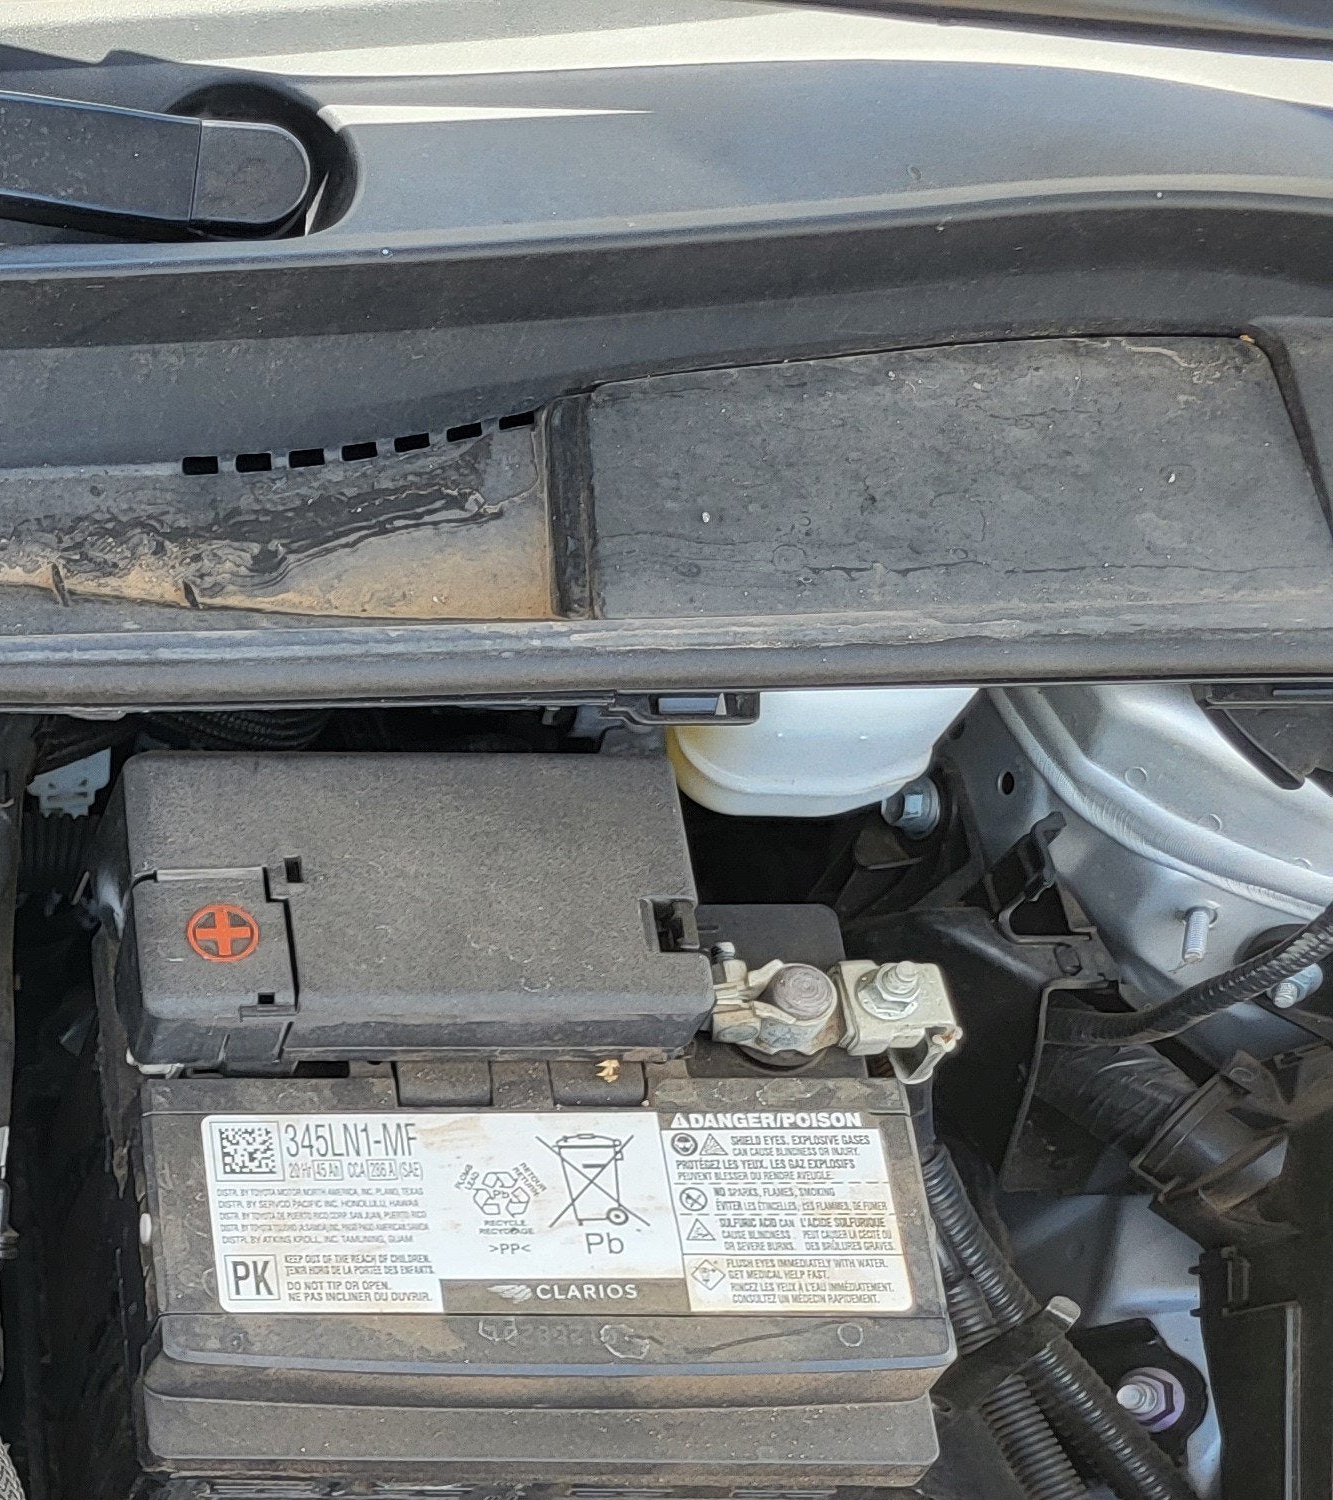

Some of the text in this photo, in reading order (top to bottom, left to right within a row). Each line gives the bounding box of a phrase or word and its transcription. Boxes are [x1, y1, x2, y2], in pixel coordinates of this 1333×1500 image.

[688, 1111, 862, 1128] DANGER/POISON
[284, 1122, 417, 1157] 345LN1-MF
[347, 1161, 365, 1178] CCA
[399, 1161, 424, 1180] (SAE)
[585, 1233, 625, 1254] Pb
[231, 1261, 274, 1295] PK
[287, 1281, 391, 1290] DO NOT TIP OR OPEN.
[536, 1284, 638, 1299] CLARIOS
